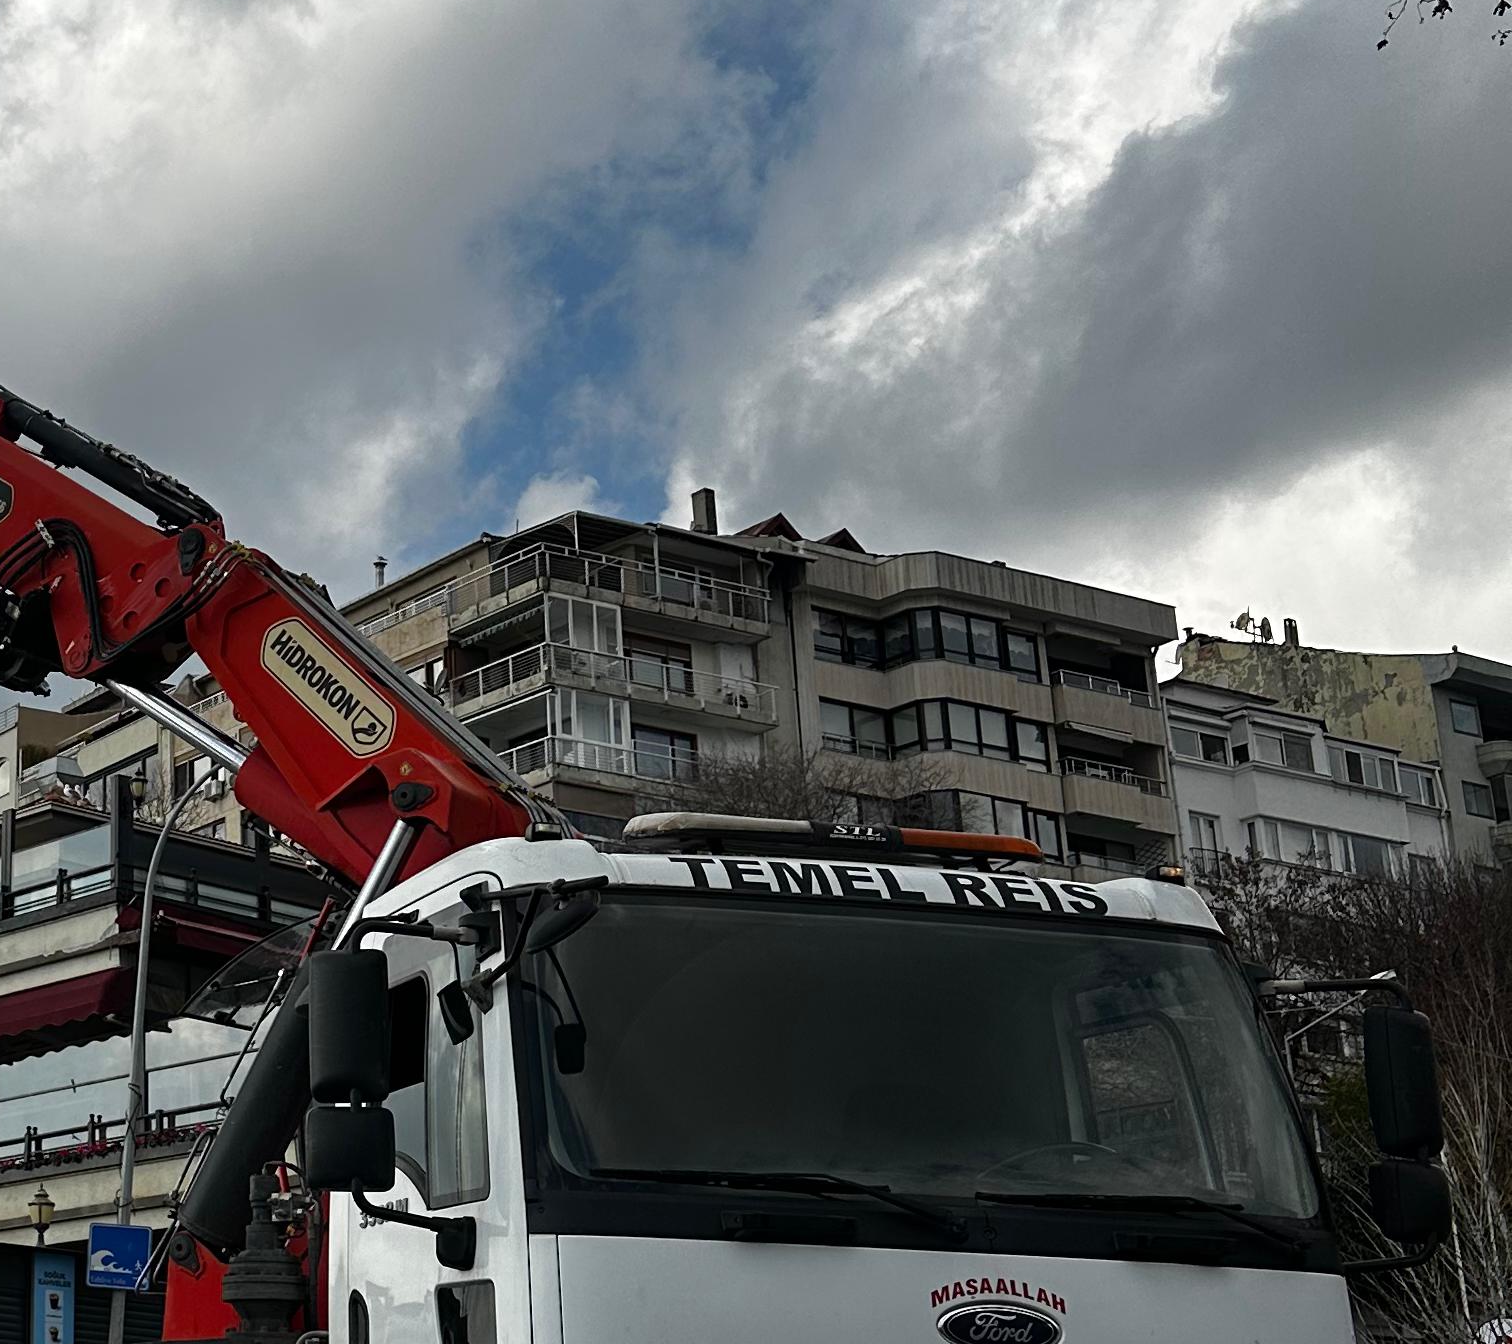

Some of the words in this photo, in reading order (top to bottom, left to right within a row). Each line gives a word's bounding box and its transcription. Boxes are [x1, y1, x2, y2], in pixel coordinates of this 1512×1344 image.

[833, 825, 881, 836] STL
[668, 856, 929, 903] TEMEL
[969, 1312, 1033, 1343] Ford
